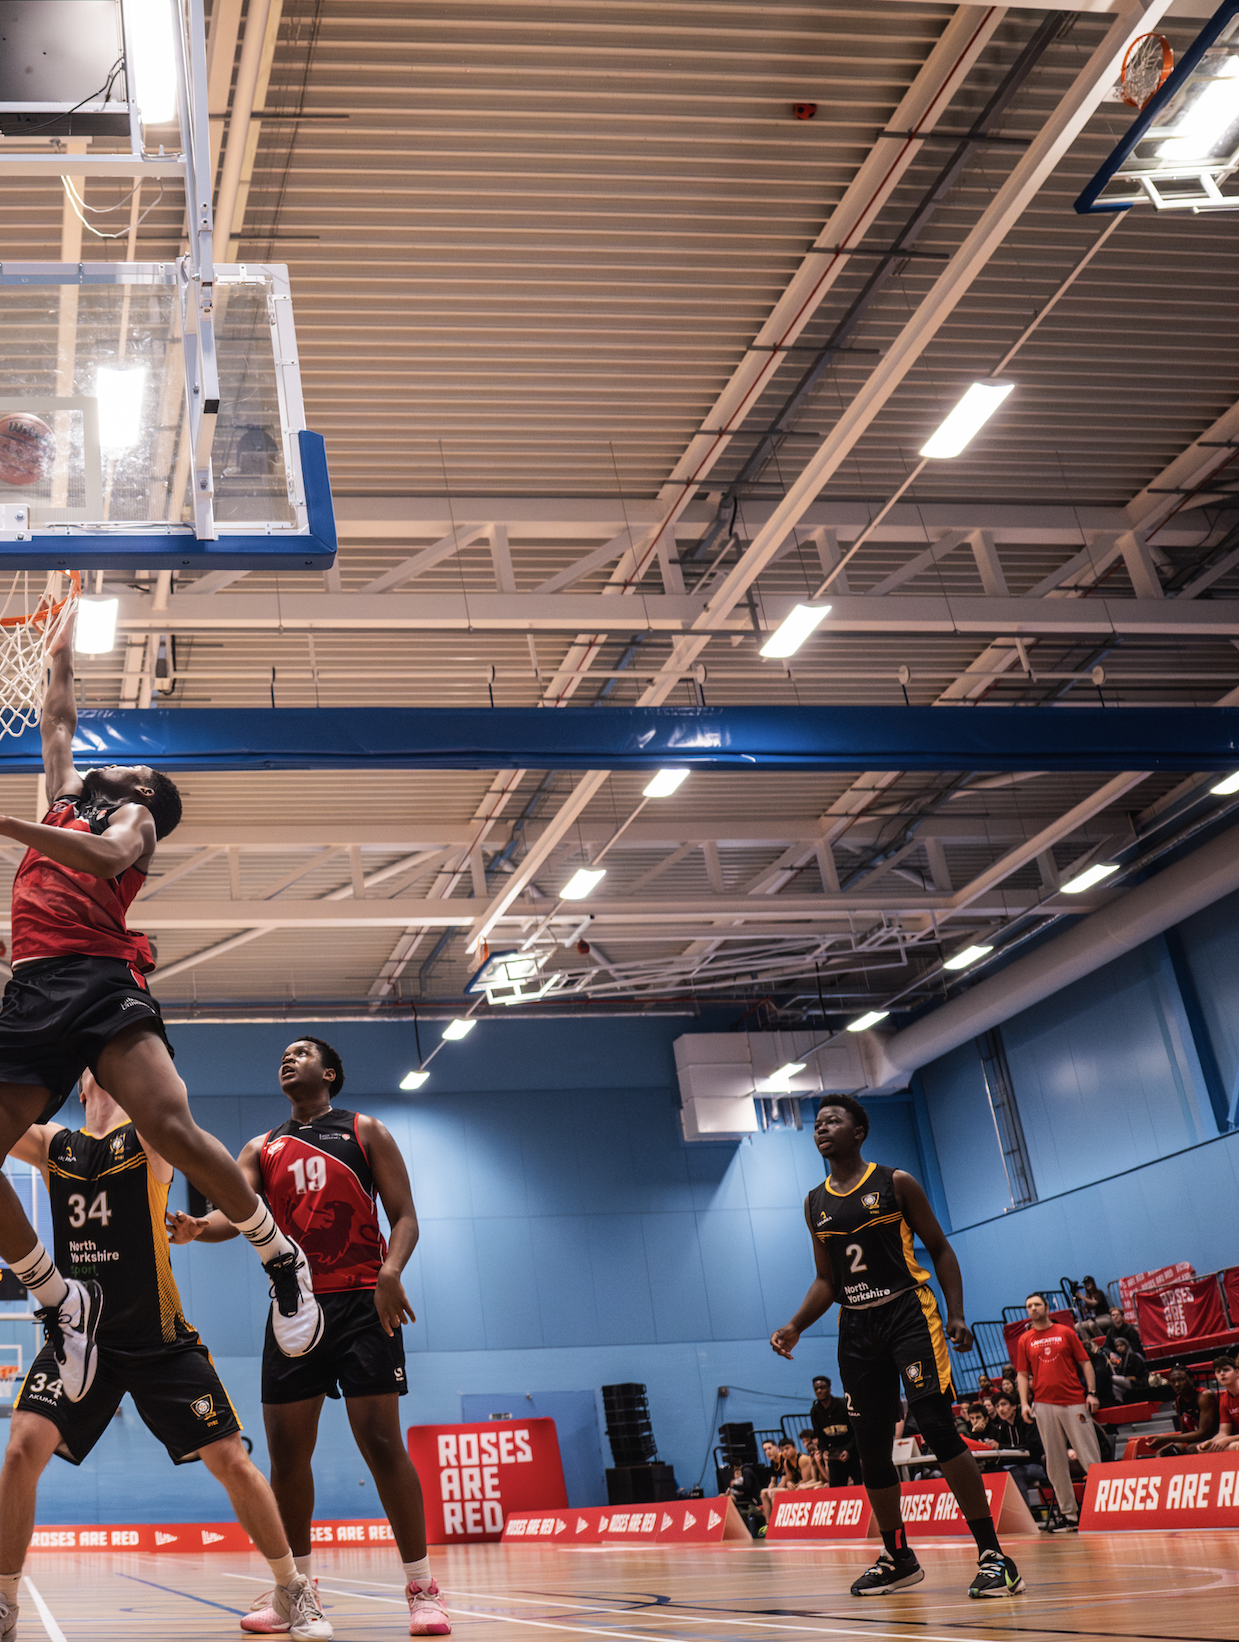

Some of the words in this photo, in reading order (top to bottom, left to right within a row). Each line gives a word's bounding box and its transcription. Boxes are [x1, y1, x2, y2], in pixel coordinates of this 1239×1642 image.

[287, 1155, 327, 1195] 19
[68, 1190, 112, 1228] 34
[69, 1240, 97, 1252] North
[70, 1250, 120, 1264] Yorkshire
[845, 1243, 868, 1273] 2
[844, 1281, 869, 1295] North
[847, 1287, 891, 1304] Yorkshire
[1159, 1287, 1195, 1307] ROSES
[1164, 1304, 1186, 1322] ARE
[1167, 1320, 1188, 1338] RED
[1030, 1337, 1063, 1348] LANCASTER
[30, 1372, 64, 1400] 34
[28, 1393, 58, 1407] AKUMA
[437, 1429, 533, 1467] ROSES
[440, 1466, 502, 1501] ARE
[1094, 1475, 1162, 1512] ROSES
[1166, 1472, 1212, 1509] ARE
[774, 1502, 813, 1527] ROSES
[811, 1500, 838, 1526] ARE
[834, 1499, 863, 1525] RED
[933, 1491, 959, 1520] ARE
[442, 1500, 504, 1535] RED
[30, 1531, 75, 1547] ROSES
[79, 1531, 107, 1546] ARE
[111, 1530, 139, 1546] RED
[310, 1527, 334, 1542] SES
[336, 1526, 365, 1541] ARE
[368, 1525, 395, 1540] RED
